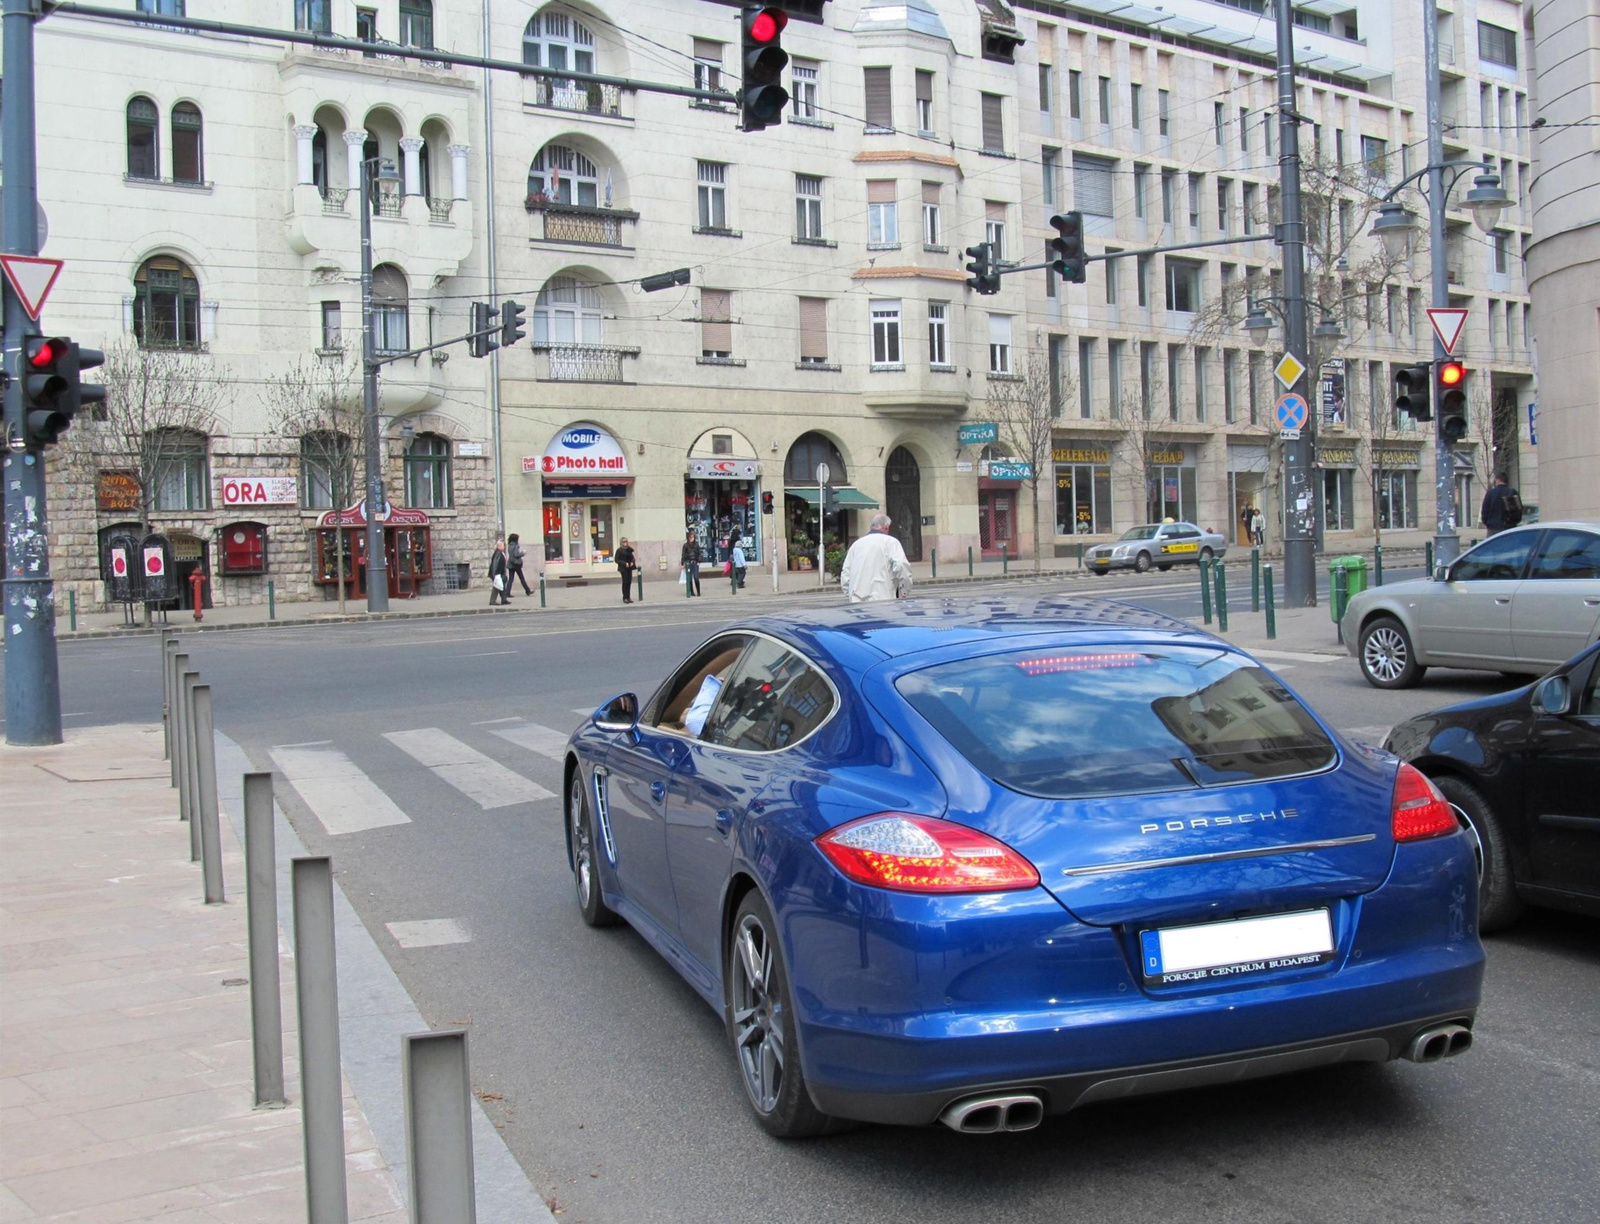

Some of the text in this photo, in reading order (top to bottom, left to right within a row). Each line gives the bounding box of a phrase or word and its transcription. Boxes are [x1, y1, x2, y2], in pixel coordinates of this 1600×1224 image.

[562, 434, 601, 444] MOBILE
[960, 429, 994, 440] OPTIKA
[557, 456, 623, 469] Photo hall
[991, 465, 1031, 476] OPTIKA
[1056, 479, 1071, 488] -5%
[110, 500, 136, 509] BOLT
[1076, 511, 1091, 521] -5%
[1141, 808, 1299, 834] PORSCHE
[1150, 957, 1158, 968] D
[1162, 954, 1322, 984] PORSCHE CENTRUM BUDAPEST
